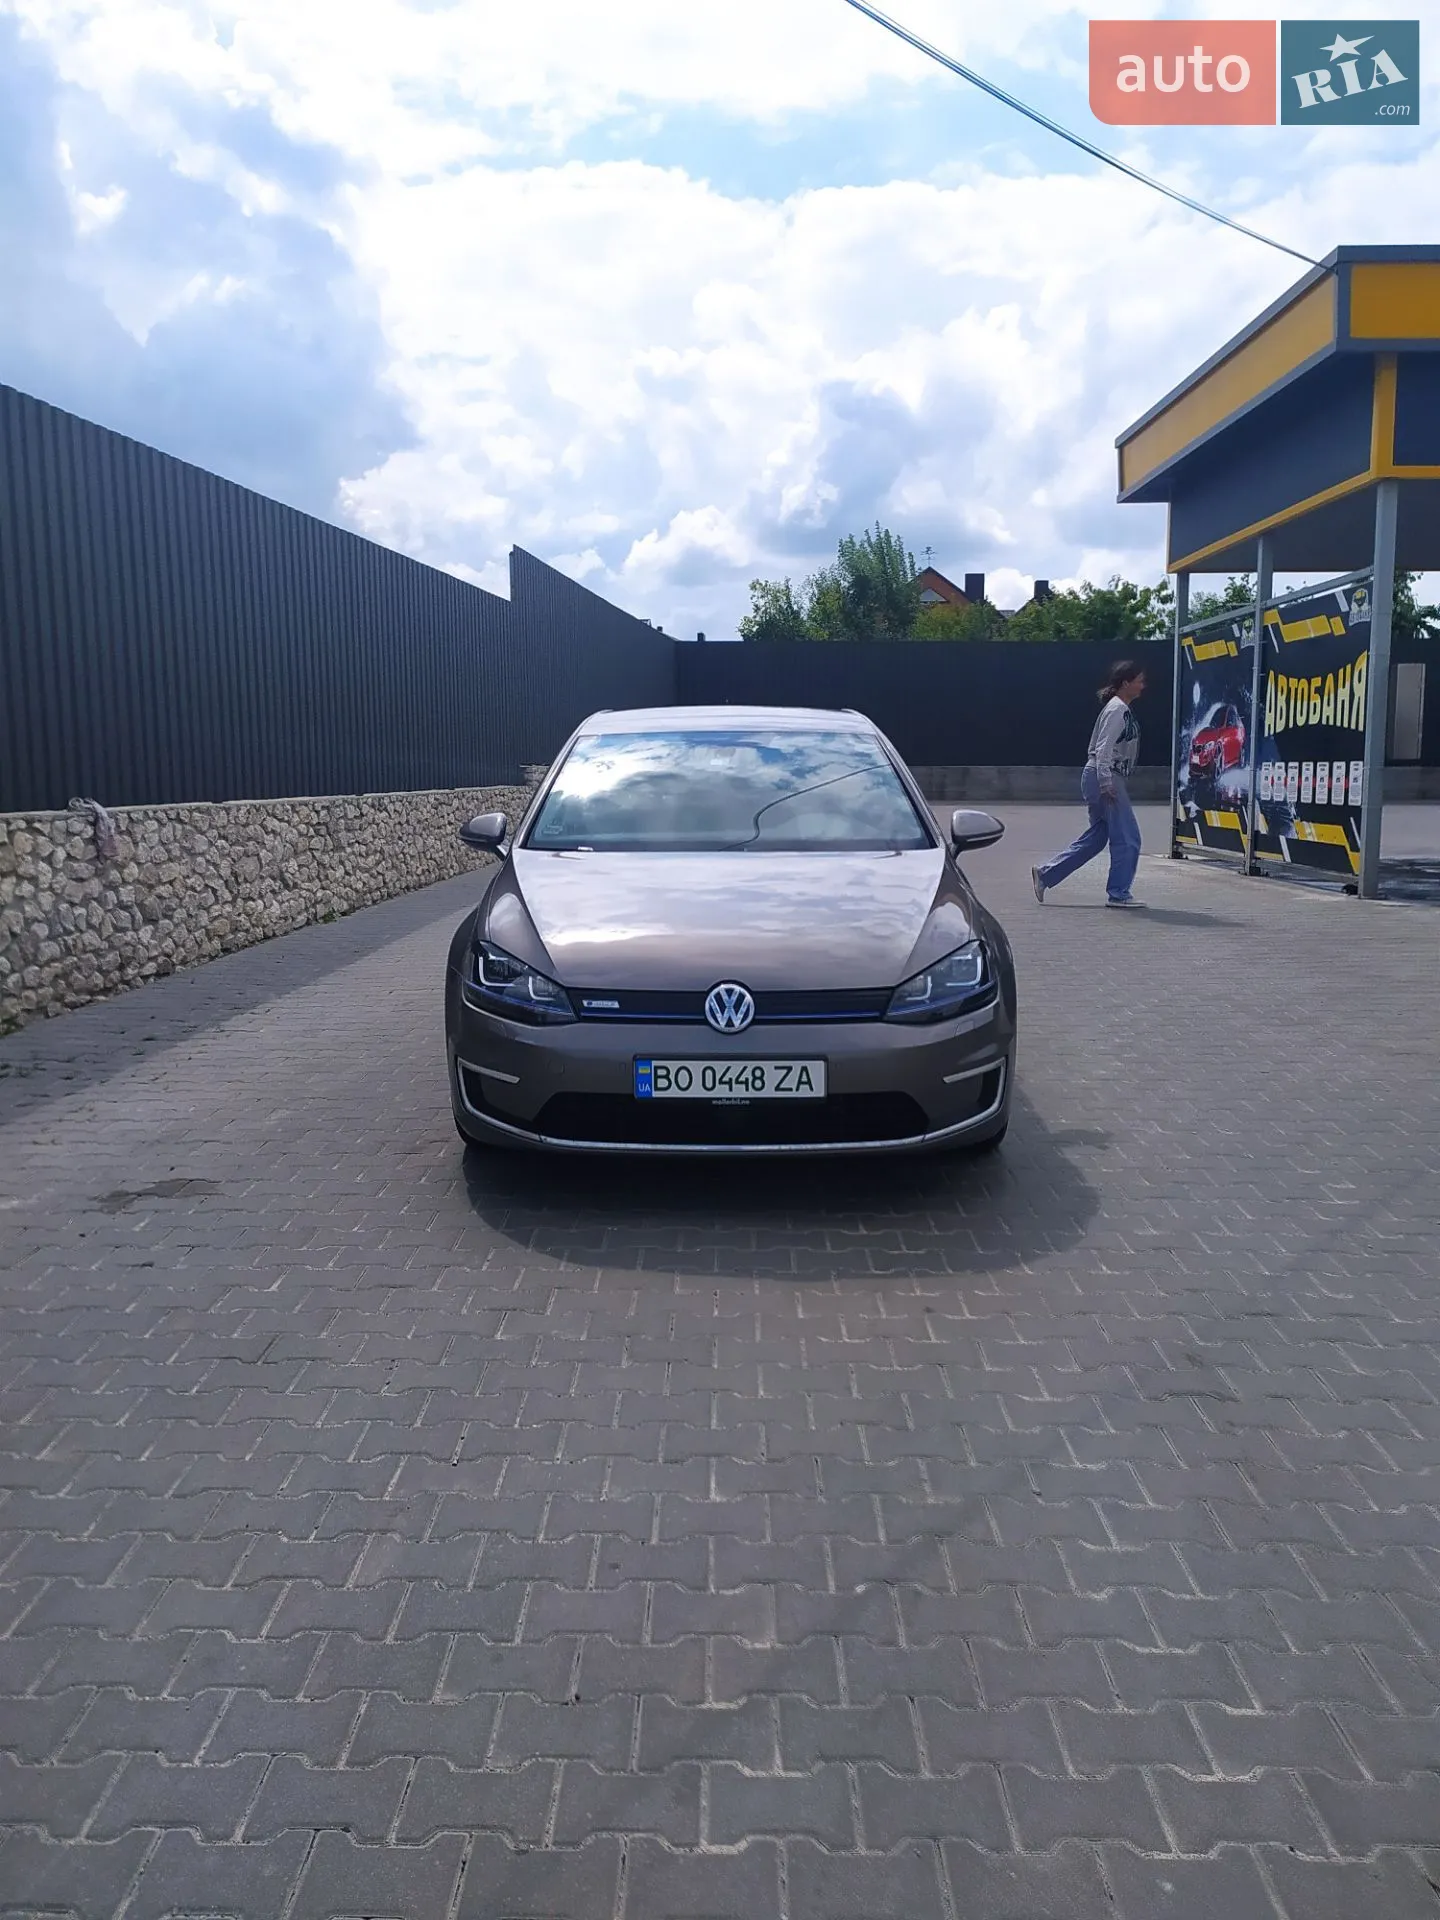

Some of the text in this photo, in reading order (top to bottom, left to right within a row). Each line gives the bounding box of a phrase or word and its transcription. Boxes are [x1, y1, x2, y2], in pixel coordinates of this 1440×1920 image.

[1264, 649, 1368, 738] АВТОБАНЯ
[638, 1083, 652, 1093] UA
[653, 1065, 815, 1092] BO 0448 ZA
